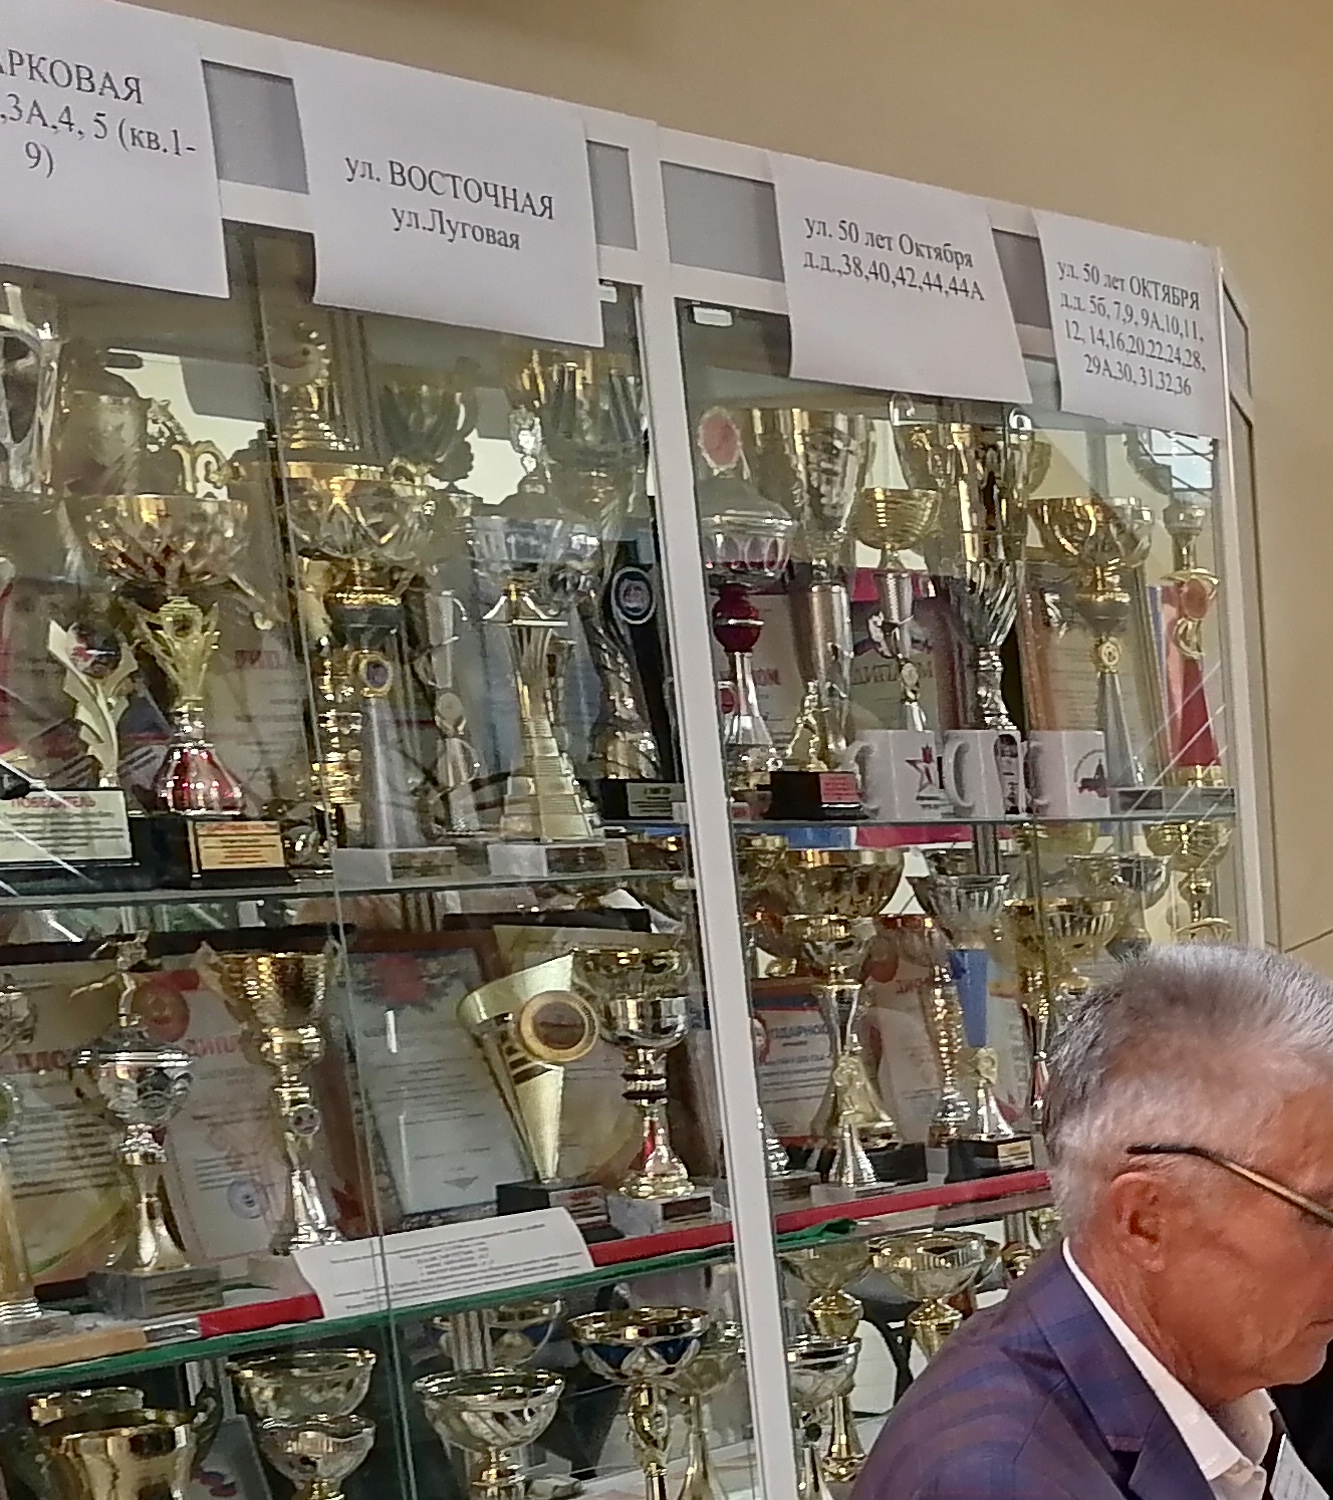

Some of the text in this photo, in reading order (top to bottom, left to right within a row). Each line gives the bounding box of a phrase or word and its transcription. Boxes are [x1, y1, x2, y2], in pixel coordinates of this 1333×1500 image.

[0, 49, 144, 105] РКОВАЯ
[25, 141, 55, 179] 9)
[345, 157, 554, 220] ул. ВОСТОЧНАЯ
[391, 207, 521, 250] ул.Луговая
[804, 217, 974, 271] ул. 50 лет Октября
[1057, 261, 1201, 311] ул. 50 лет ОКТЯБРЯ
